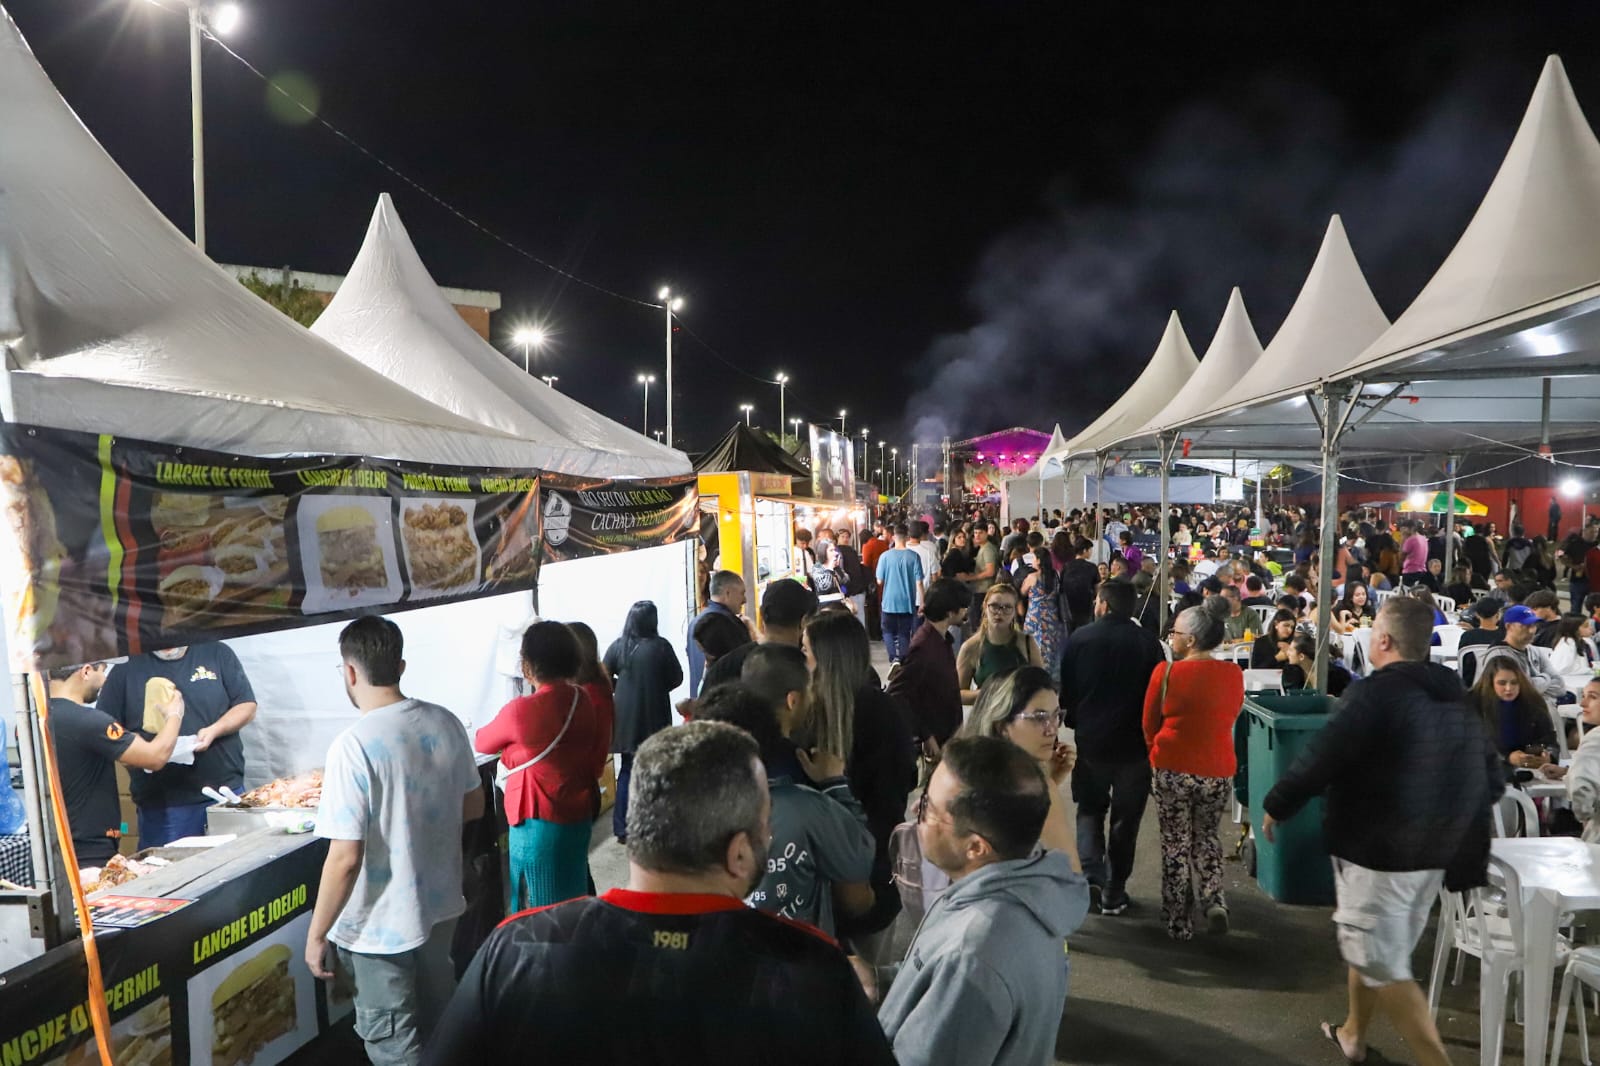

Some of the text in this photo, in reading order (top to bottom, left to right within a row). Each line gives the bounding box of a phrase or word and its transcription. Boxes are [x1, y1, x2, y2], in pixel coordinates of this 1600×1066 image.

[156, 461, 274, 489] LANCHE DE PERNIL
[296, 468, 388, 489] LANCHE DE JOELHO
[591, 512, 636, 533] CACHAÇA
[777, 894, 804, 920] TIC
[193, 884, 307, 965] LANCHE DE JOELHO
[653, 930, 689, 950] 1981
[0, 1014, 67, 1066] NCHE
[104, 963, 161, 1011] PERNIL
